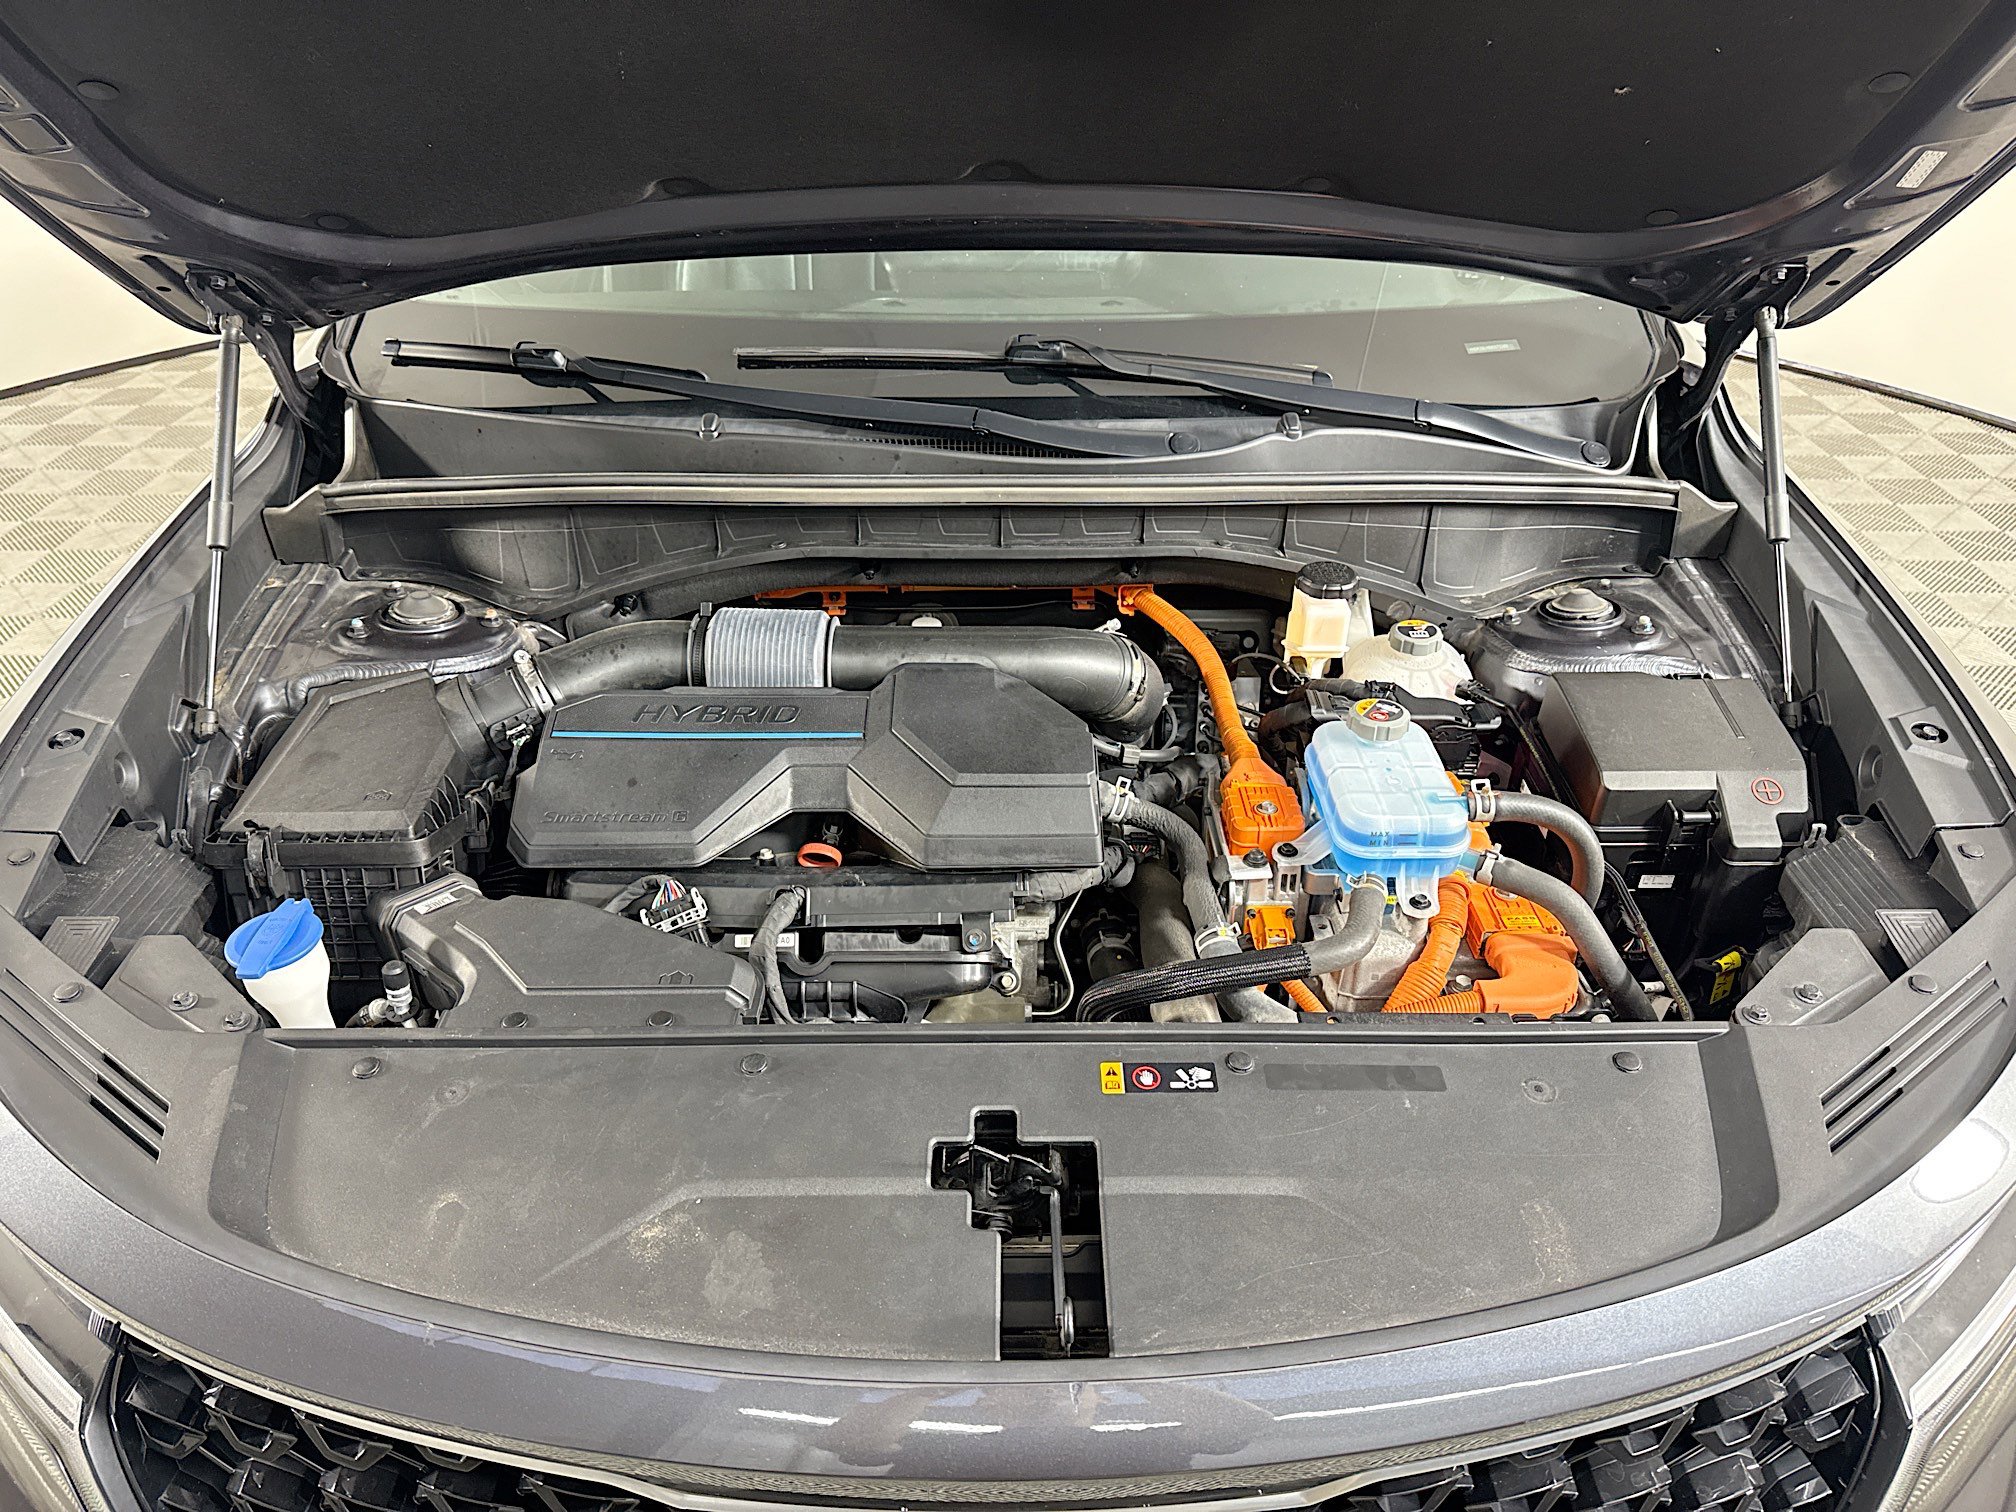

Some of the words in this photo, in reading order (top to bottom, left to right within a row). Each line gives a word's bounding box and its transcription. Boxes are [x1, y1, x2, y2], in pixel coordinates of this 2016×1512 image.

[631, 704, 802, 725] HYBRID
[540, 810, 669, 824] Smartstream
[673, 811, 688, 823] G
